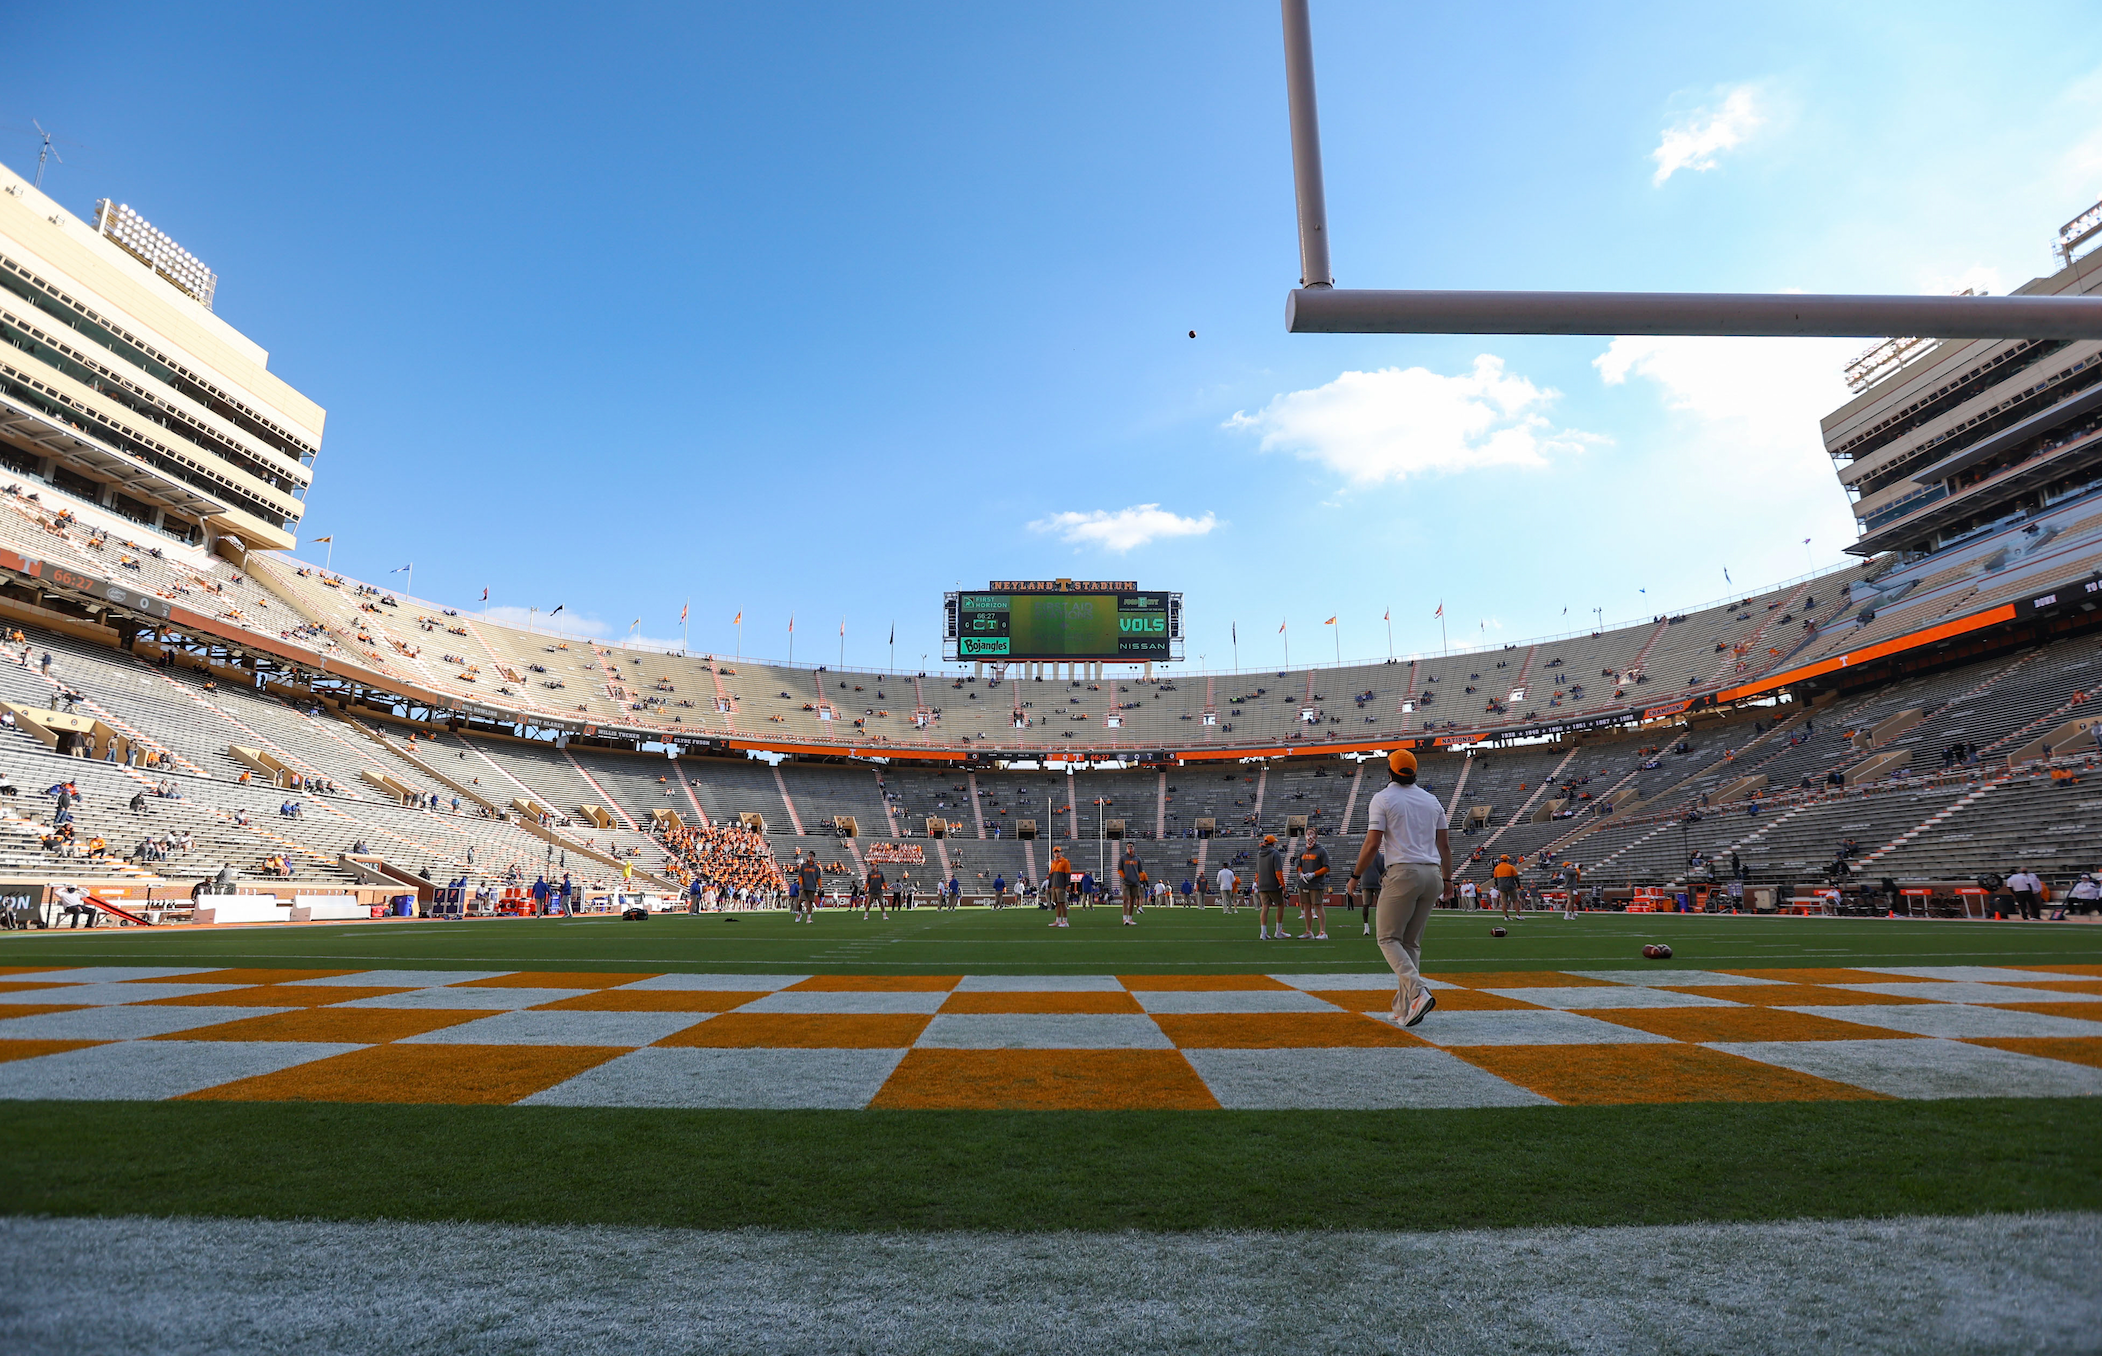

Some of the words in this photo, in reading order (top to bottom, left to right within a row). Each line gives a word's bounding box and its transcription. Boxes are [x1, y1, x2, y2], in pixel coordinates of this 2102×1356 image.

[53, 569, 94, 590] 66:27
[994, 582, 1053, 590] NEYLAND
[1055, 578, 1072, 592] T
[1074, 582, 1133, 590] STADIUM
[2085, 582, 2098, 593] TO
[140, 598, 149, 609] 0
[1035, 602, 1067, 611] FIRST
[1072, 602, 1093, 611] AID
[1035, 610, 1094, 620] STATIONS
[1120, 618, 1165, 632] VOLS
[964, 639, 1007, 653] Bojangles
[1648, 704, 1684, 717] CHAMPIONS
[1442, 736, 1476, 744] NATIONAL
